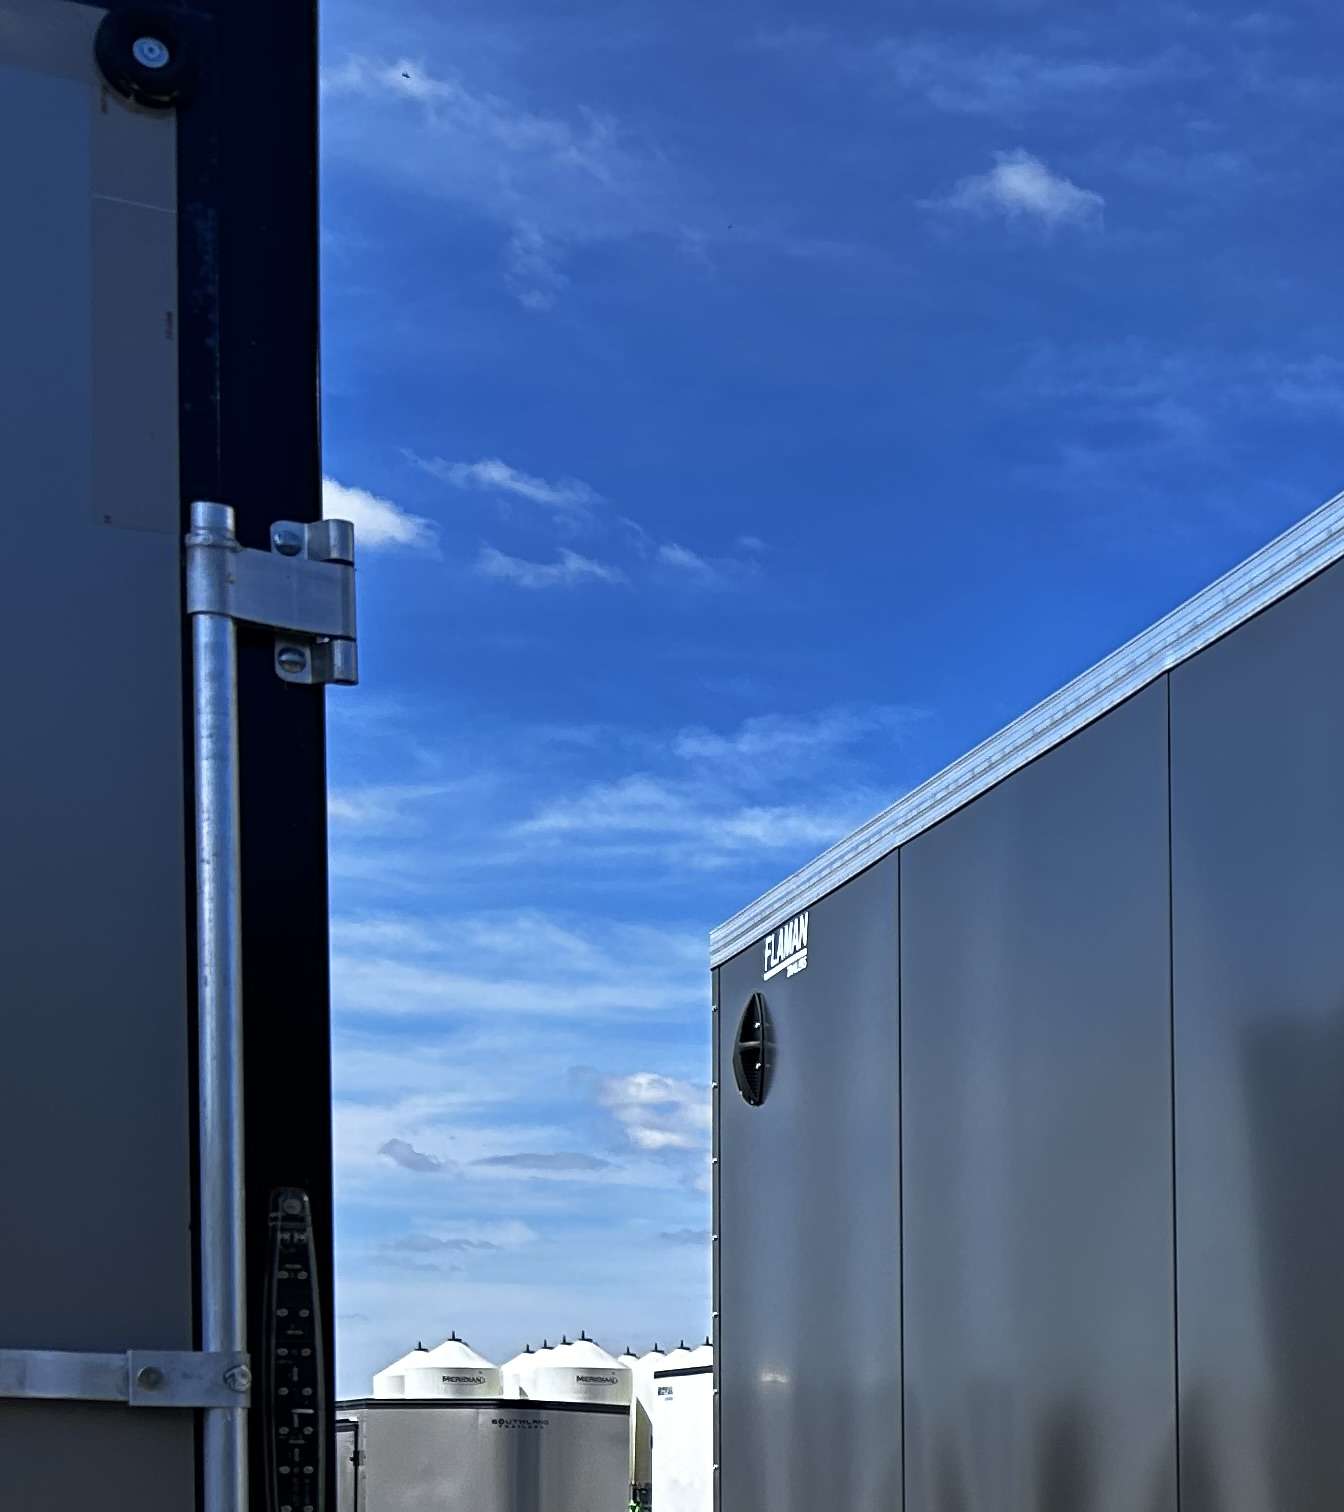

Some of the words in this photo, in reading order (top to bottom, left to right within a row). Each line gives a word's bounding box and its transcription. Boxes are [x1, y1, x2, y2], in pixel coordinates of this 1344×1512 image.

[764, 911, 809, 972] FLAMAN
[442, 1375, 482, 1385] MERIDIAN
[576, 1375, 615, 1385] MERIDIAN
